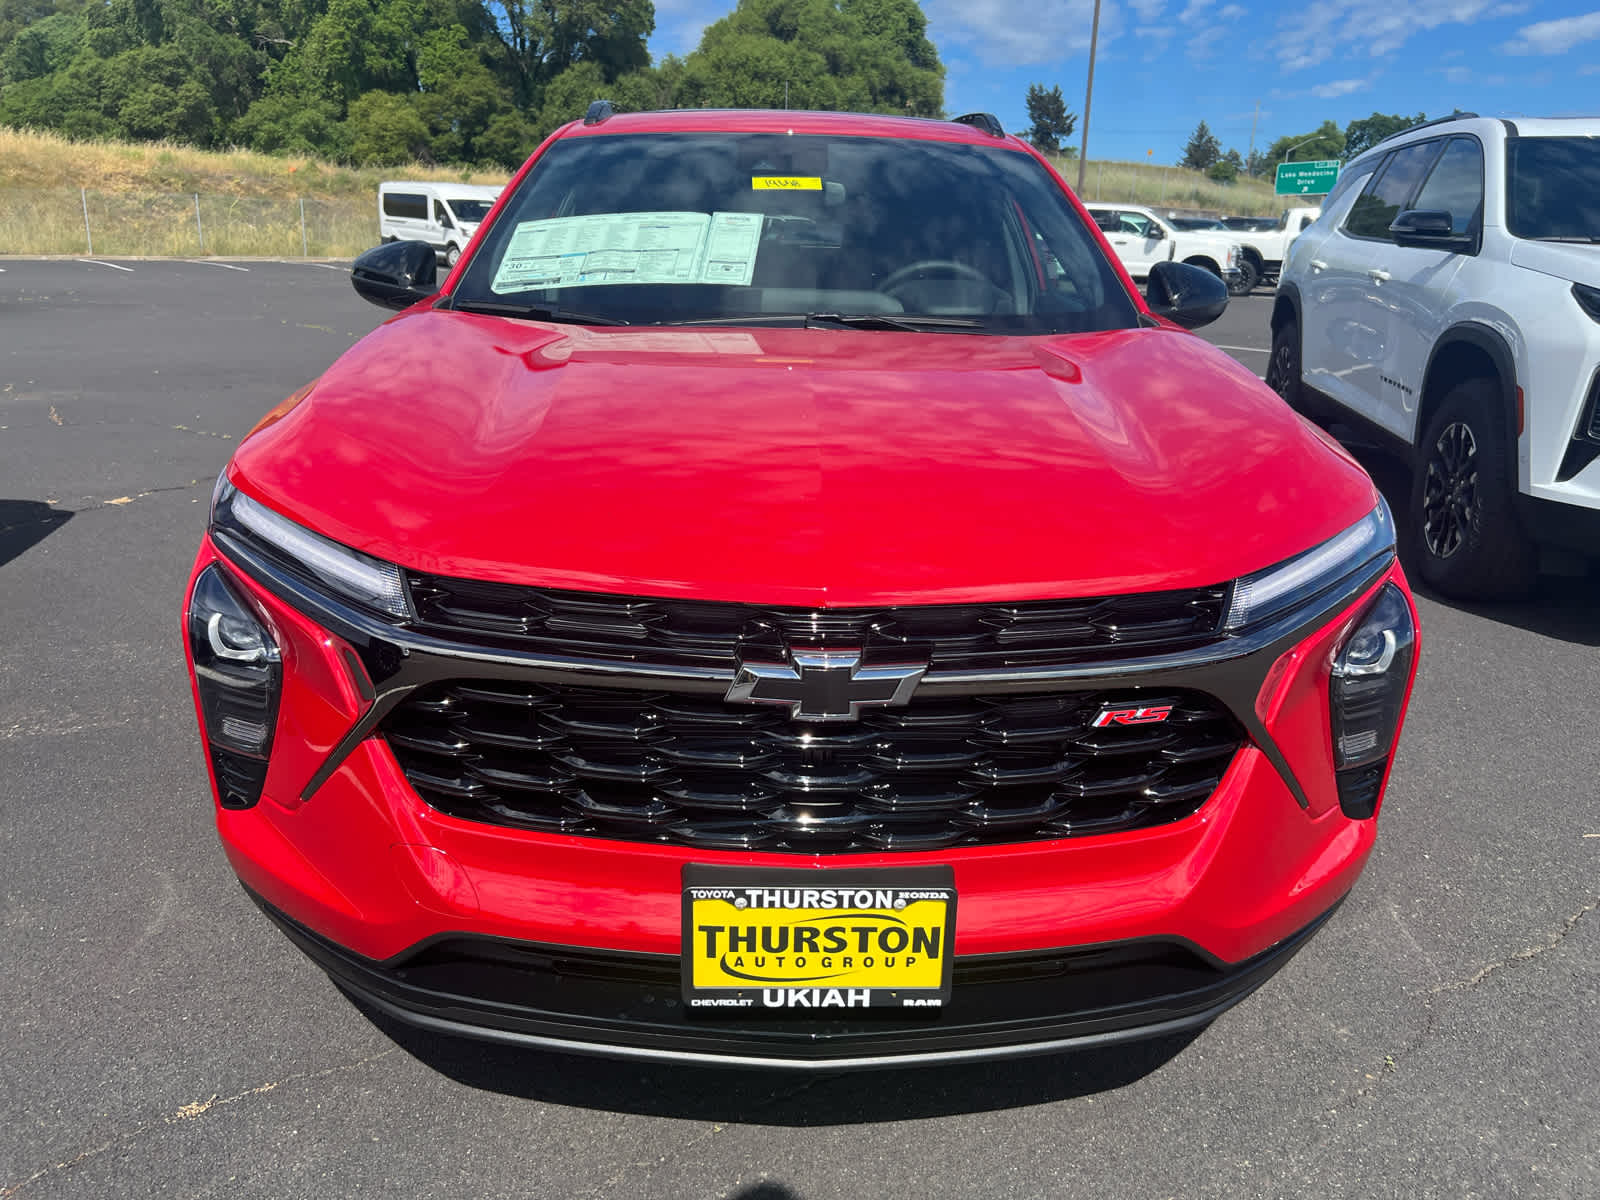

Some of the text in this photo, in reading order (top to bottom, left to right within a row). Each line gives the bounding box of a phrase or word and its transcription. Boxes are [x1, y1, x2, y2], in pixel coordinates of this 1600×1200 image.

[1091, 705, 1173, 728] RS
[691, 890, 736, 899] TOYOTA
[745, 889, 893, 909] THURSTON
[898, 891, 950, 899] HONDA
[698, 925, 941, 959] THURSTON
[734, 956, 917, 968] AUTO GROUP
[691, 999, 754, 1007] CHEVROLET
[763, 988, 871, 1008] UKIAH
[903, 999, 943, 1007] RAM
